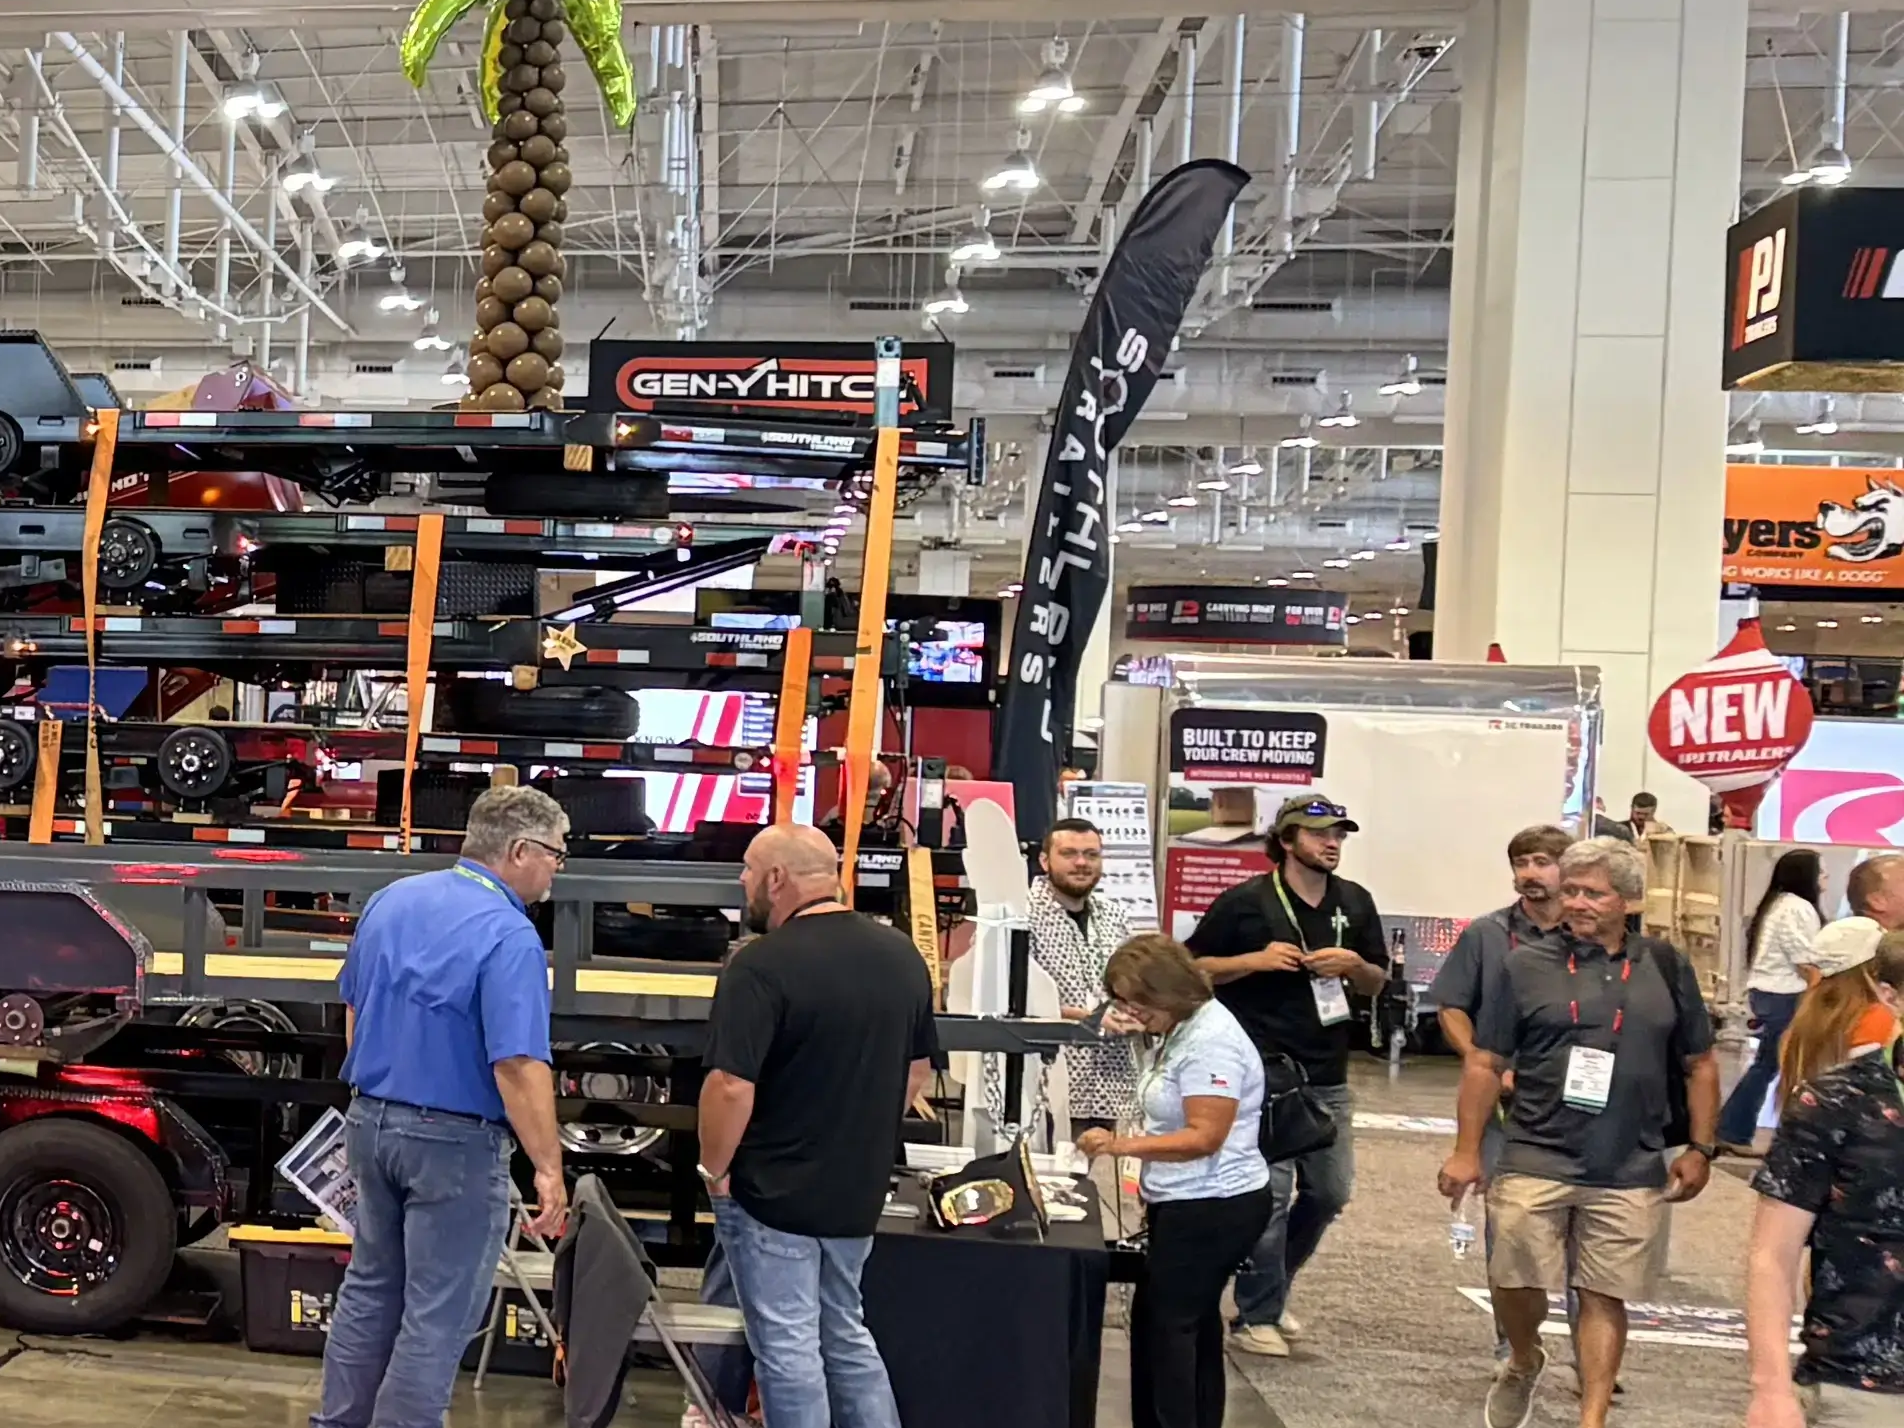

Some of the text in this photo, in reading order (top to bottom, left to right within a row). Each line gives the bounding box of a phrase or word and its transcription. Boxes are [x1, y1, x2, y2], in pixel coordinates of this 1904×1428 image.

[1747, 228, 1786, 320] PJ
[632, 357, 908, 399] GEN-Y HITC
[769, 432, 855, 446] SOUTHLAND
[1741, 567, 1792, 579] WORKS
[1794, 568, 1822, 580] LIKE
[1824, 571, 1834, 581] A
[698, 632, 784, 644] SOUTHLAND
[1669, 678, 1792, 747] NEW
[1183, 728, 1317, 749] BUILT TO KEEP
[1184, 747, 1315, 765] YOUR CREW MOVING
[917, 914, 935, 964] CANYON
